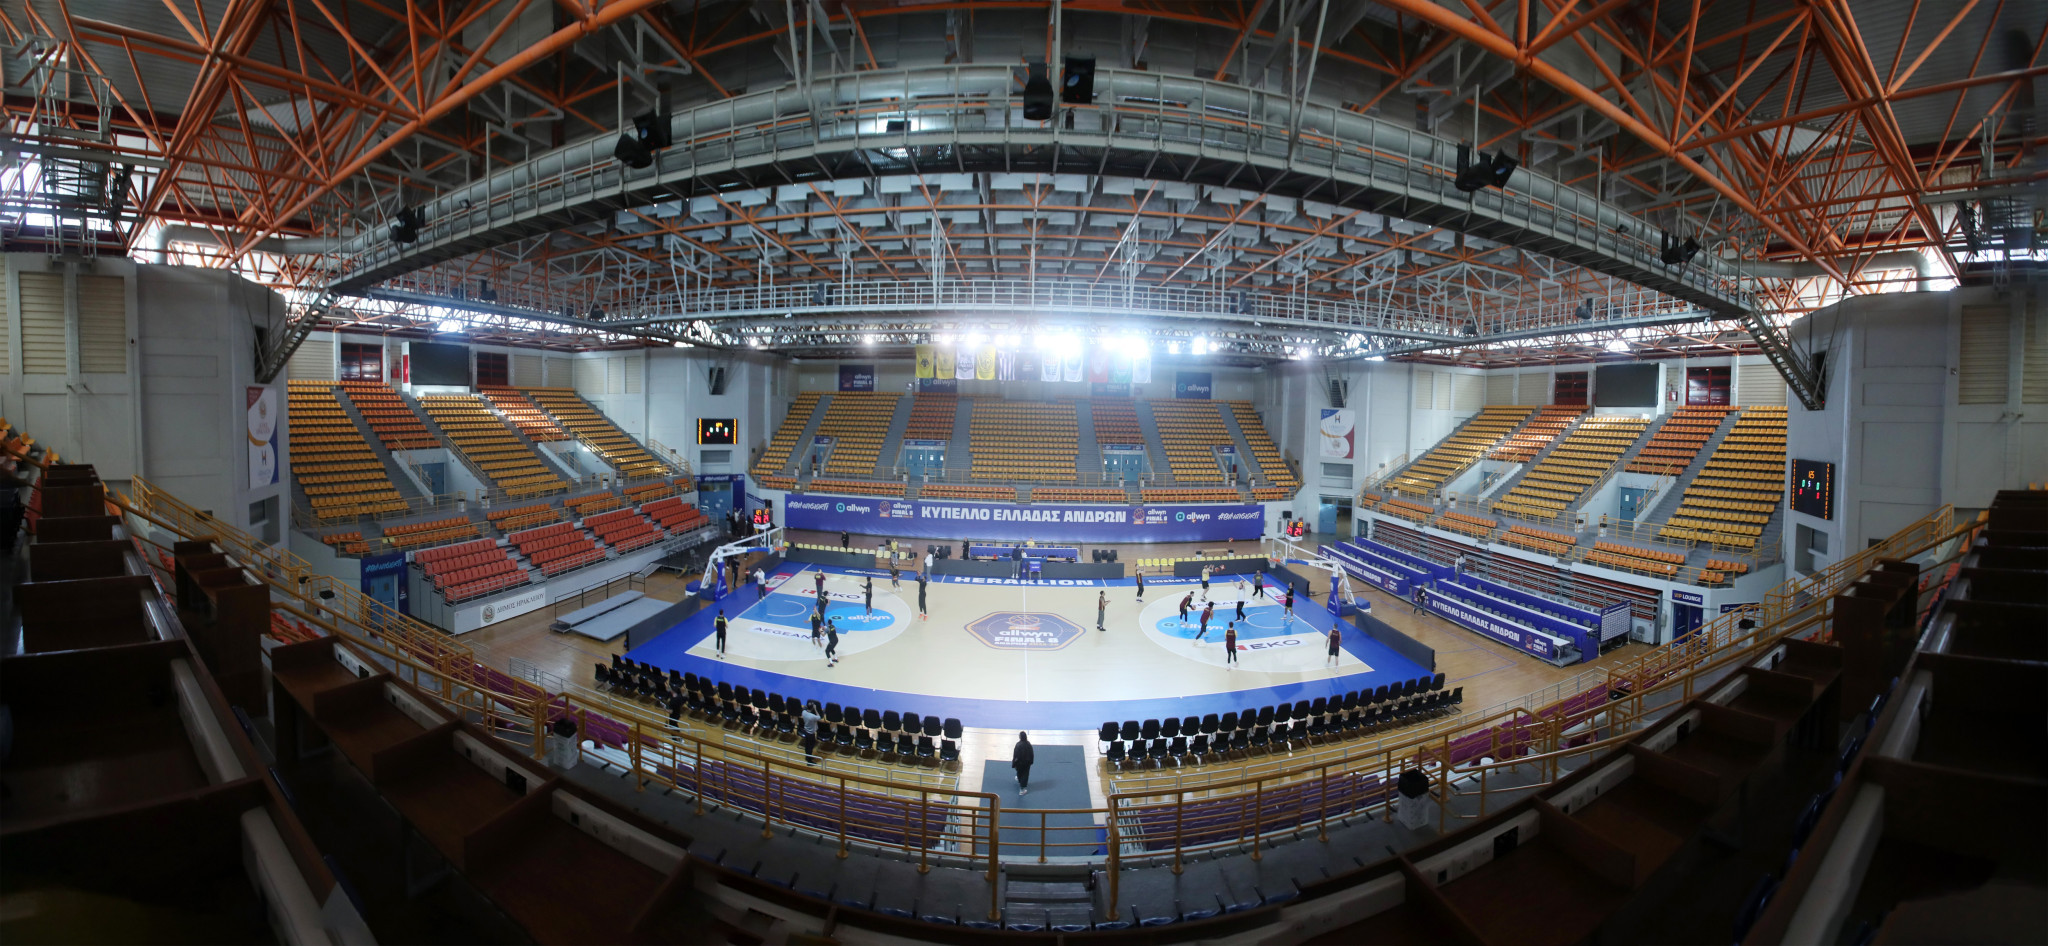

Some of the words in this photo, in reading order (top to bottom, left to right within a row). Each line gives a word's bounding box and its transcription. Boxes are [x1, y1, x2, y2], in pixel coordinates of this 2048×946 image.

[1187, 385, 1209, 393] allwyn
[847, 503, 870, 514] allwyn
[893, 502, 912, 510] allwyn
[922, 506, 990, 520] ΚΥΠΕΛΛΟ
[993, 509, 1060, 522] ΕΛΛΑΔΑΣ
[1064, 510, 1126, 523] ΑΝΔΡΩΝ
[1186, 512, 1210, 521] allwyn
[954, 576, 1094, 586] HERAKLION
[497, 603, 515, 613] ΔΗΜΟΣ
[517, 593, 544, 607] ΗΡΑΚΛΕΙΟΥ
[1683, 594, 1701, 602] LOUNGE
[1432, 600, 1460, 617] ΚΥΠΕΛΛΟ
[1461, 612, 1489, 629] ΕΛΛΑΔΑΣ
[1490, 624, 1520, 642] ΑΝΔΡΩΝ
[999, 630, 1054, 638] allwyn
[1250, 640, 1300, 650] EKO
